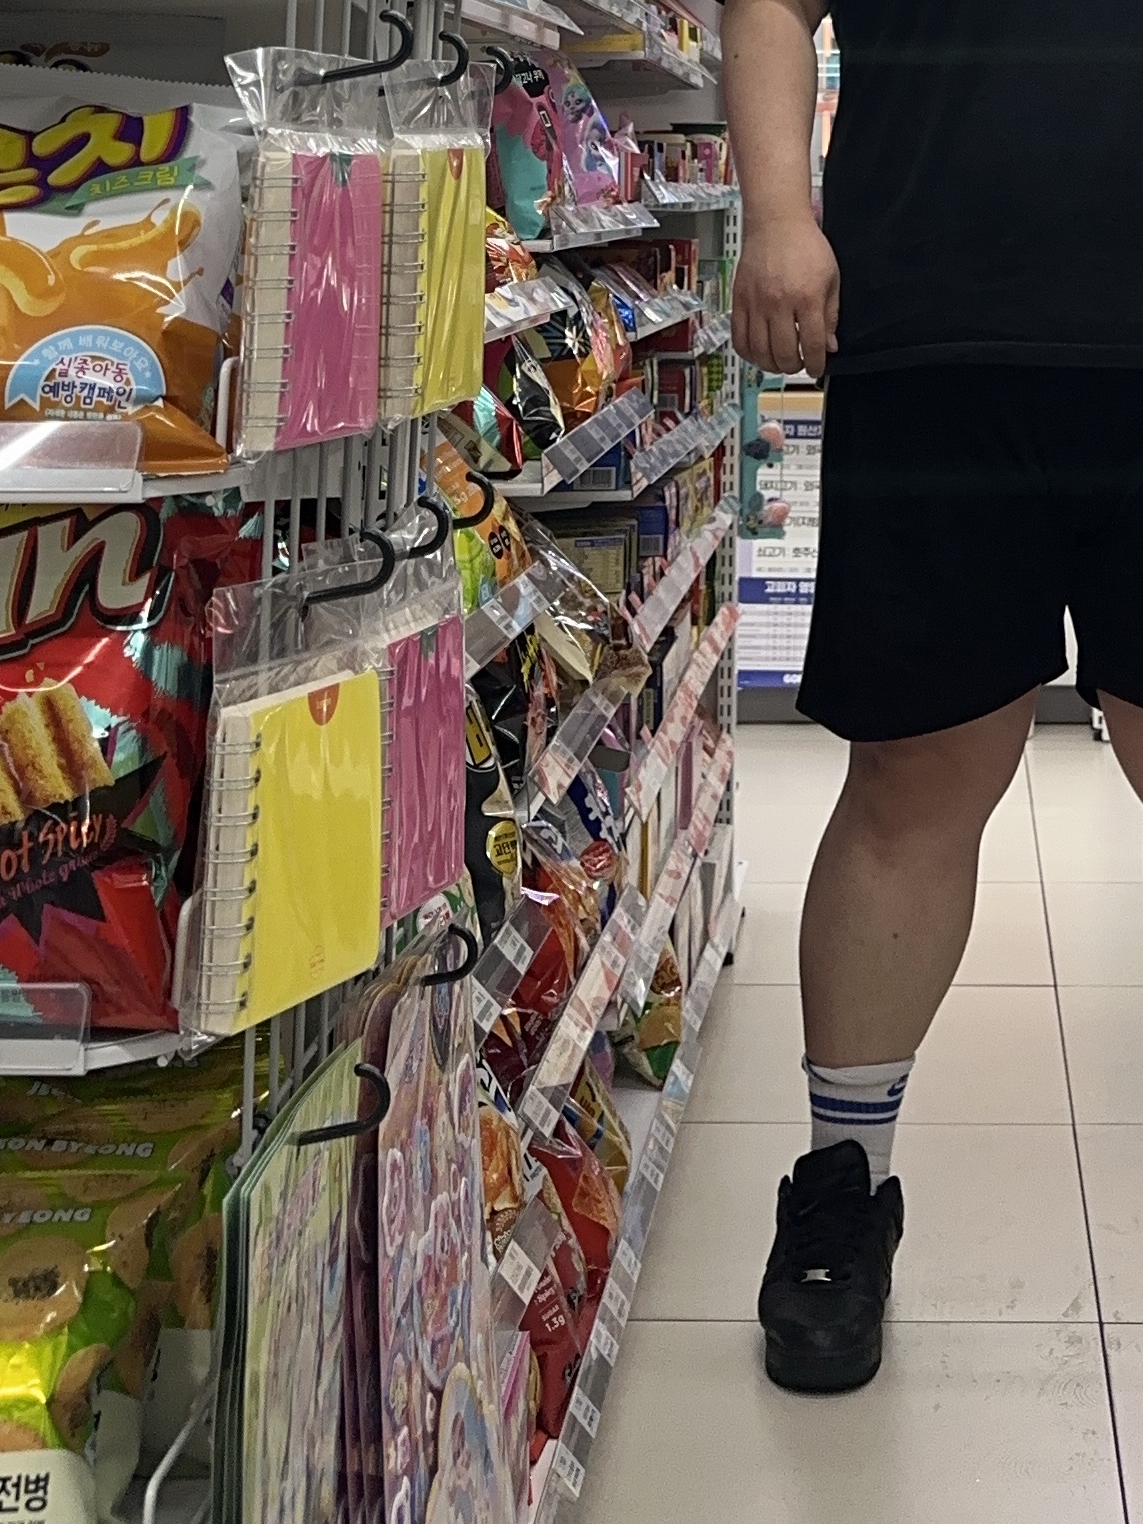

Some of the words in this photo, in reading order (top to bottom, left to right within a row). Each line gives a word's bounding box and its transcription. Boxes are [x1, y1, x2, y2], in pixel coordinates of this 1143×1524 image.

[42, 337, 74, 360] 함께
[78, 335, 149, 373] 배워보아요
[56, 356, 130, 384] 실종아동
[41, 381, 133, 410] 예방캠페인
[51, 1139, 154, 1158] BYEONG
[544, 1314, 567, 1334] 1.3g
